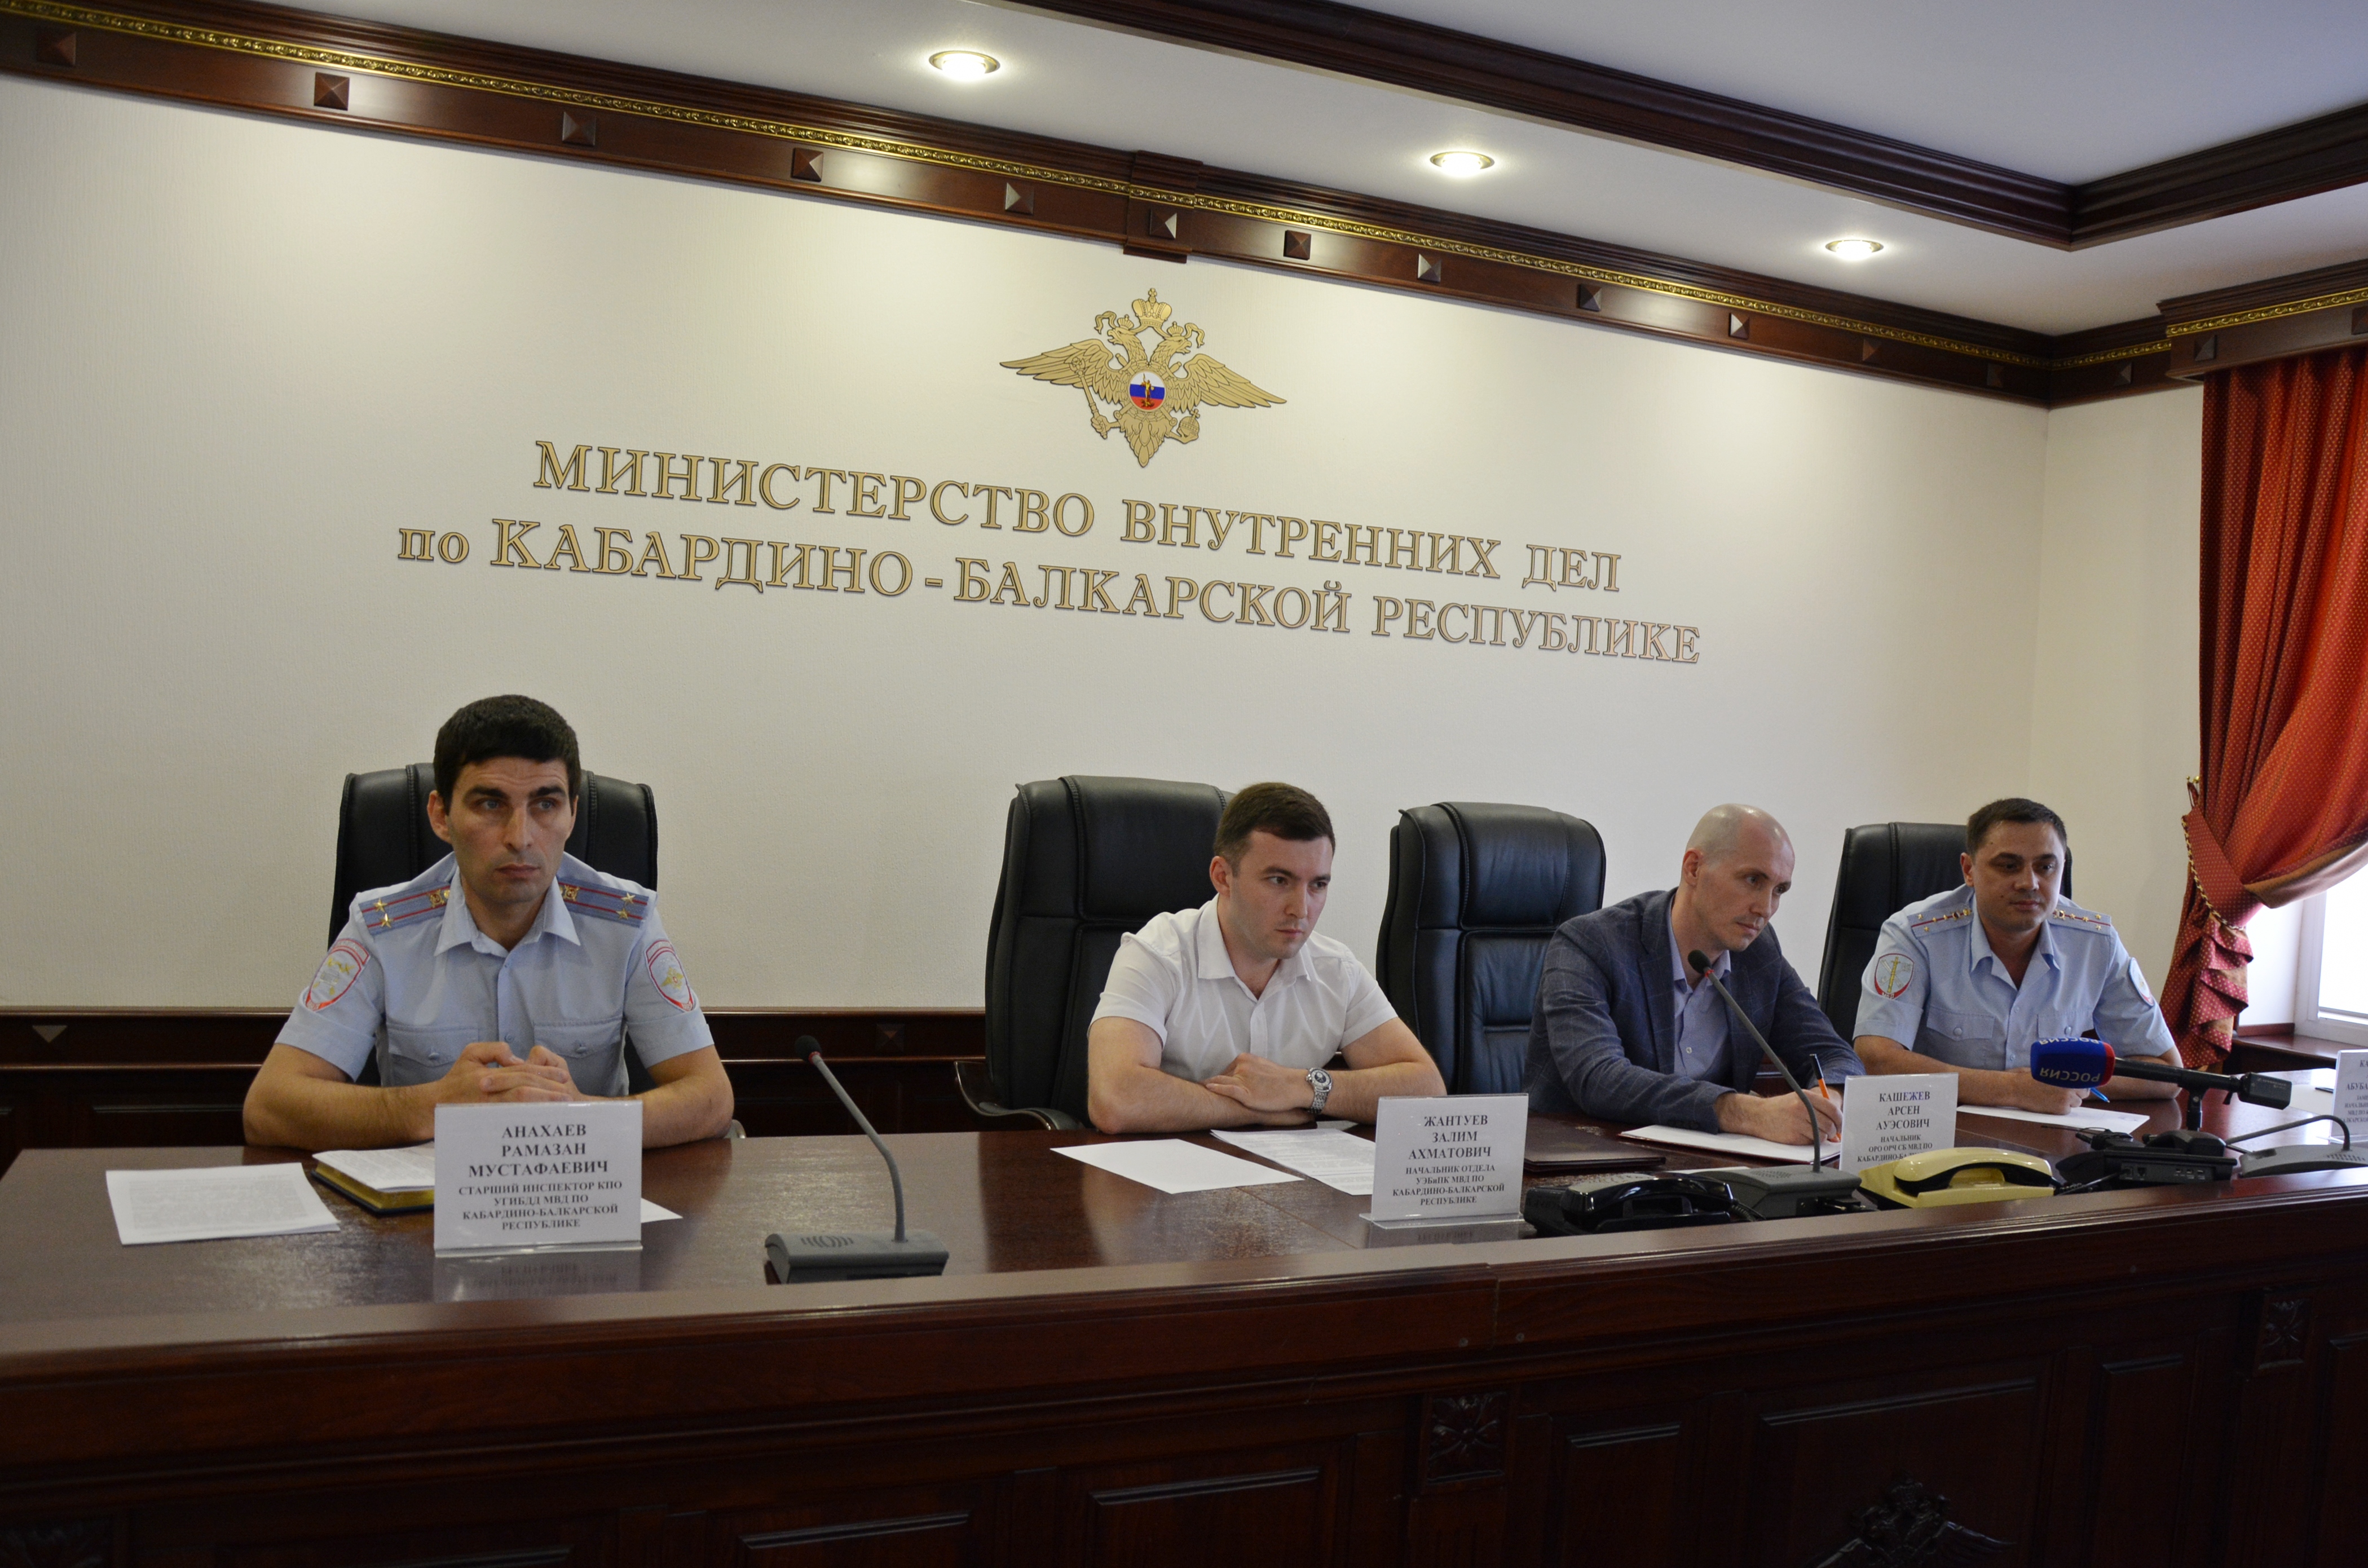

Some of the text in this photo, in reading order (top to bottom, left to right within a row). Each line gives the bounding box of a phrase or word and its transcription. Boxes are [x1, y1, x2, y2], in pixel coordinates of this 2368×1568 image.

[532, 439, 1623, 593] МИНИСТЕРСТВО ВНУТРЕННИХ ДЕЛ
[397, 526, 470, 565] по
[1370, 595, 1702, 665] РЕСПУБЛИКЕ
[2039, 1067, 2101, 1082] РОССИЯ
[1879, 1091, 1930, 1102] КАШЕЖЕВ
[1888, 1105, 1920, 1116] АРСЕН
[1424, 1115, 1488, 1127] ЖАНТУЕВ
[1876, 1119, 1930, 1130] АУЭСОВИЧ
[501, 1124, 587, 1139] АНАХАЕВ
[1432, 1131, 1478, 1143] ЗАЛИМ
[1880, 1134, 1921, 1143] НАЧАЛЬНИК
[501, 1143, 586, 1158] РАМАЗАН
[1408, 1147, 1492, 1160] АХМАТОВИЧ
[469, 1160, 608, 1178] МУСТАФАЕВИЧ
[1405, 1164, 1495, 1175] НАЧАЛЬНИК ОТДЕЛА
[1452, 1175, 1470, 1184] МВД
[458, 1181, 623, 1196] СТАРШИЙ ИНСПЕКТОР КПО
[1392, 1183, 1505, 1196] КАБАРДИНО-БАЛКАРСКОЙ
[494, 1194, 589, 1207] УГИБДД МВД ПО
[1420, 1196, 1478, 1205] РЕСПУБЛИКЕ
[462, 1203, 619, 1221] КАБАРДИНО-БАЛКАРСКОЙ
[502, 1220, 580, 1231] РЕСПУБЛИКЕ
